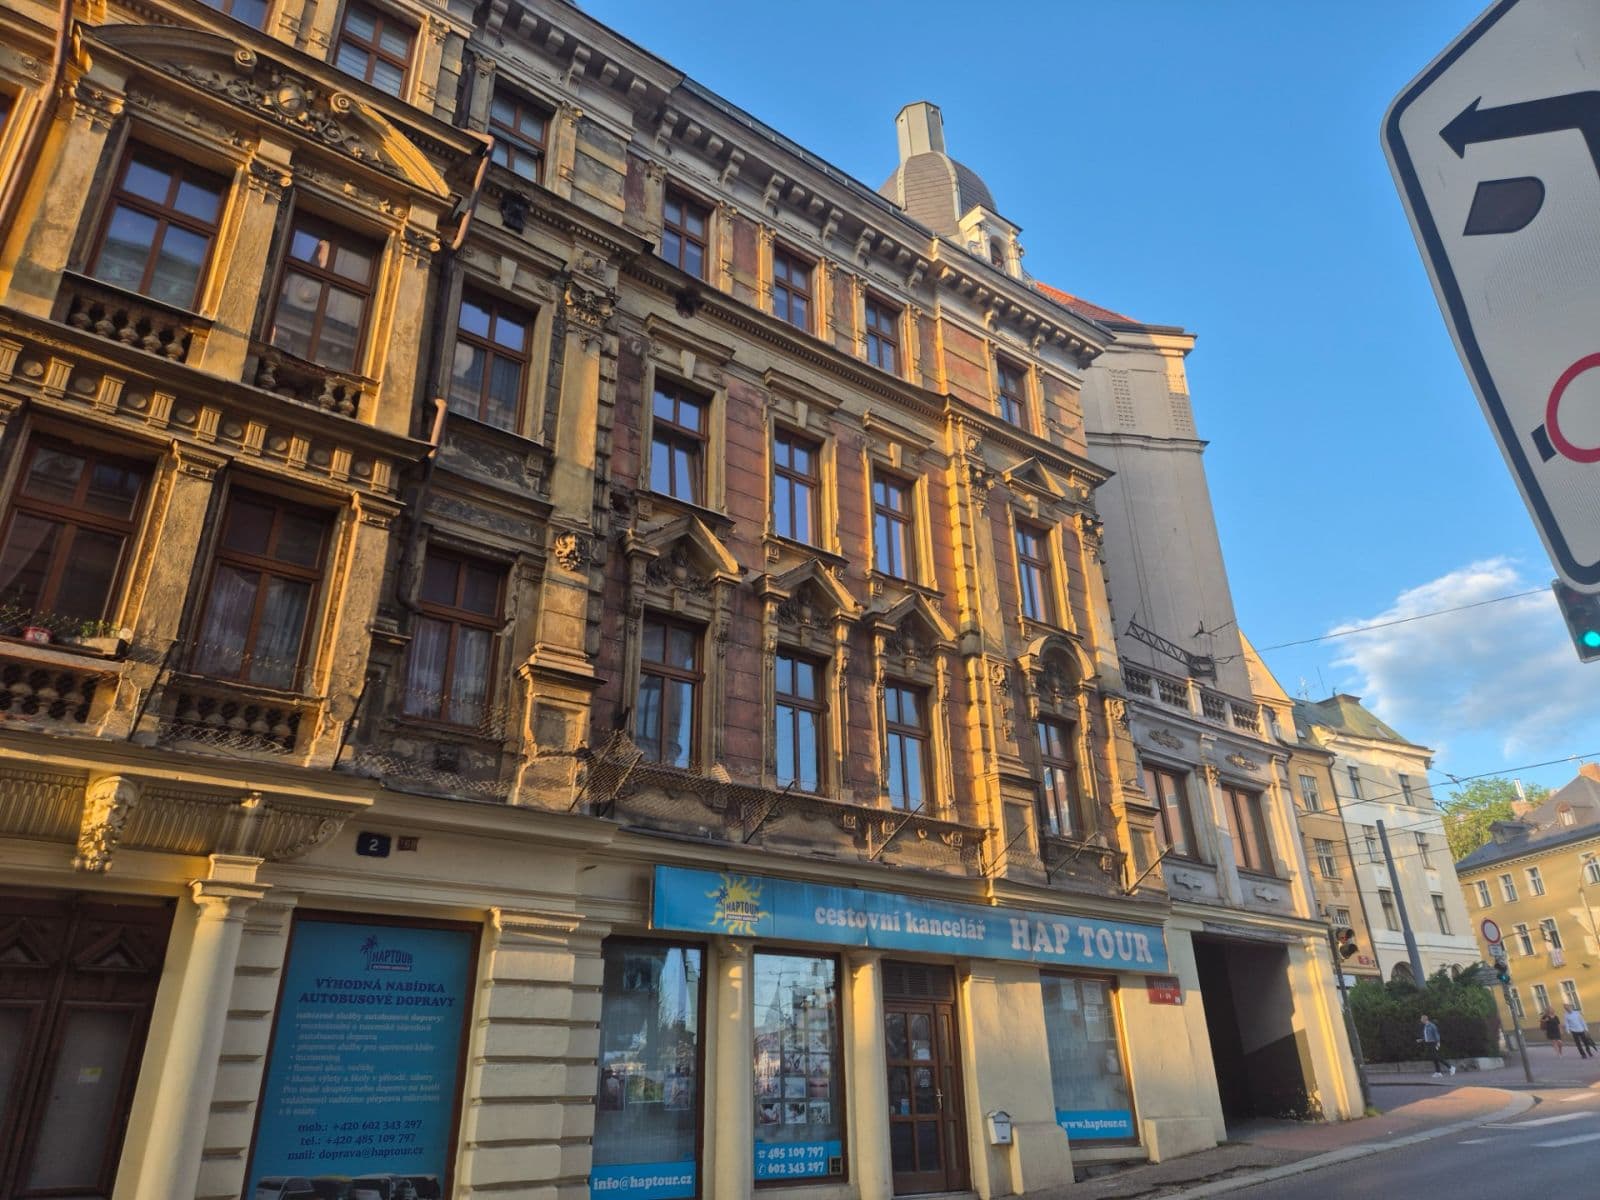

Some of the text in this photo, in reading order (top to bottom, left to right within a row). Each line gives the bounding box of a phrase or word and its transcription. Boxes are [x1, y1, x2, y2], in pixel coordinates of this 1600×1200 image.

[369, 839, 378, 851] 2
[815, 906, 1154, 964] cestovní kancelář HAP TOUR
[372, 950, 413, 963] HAPTOUR
[315, 977, 446, 993] VÝHODNÁ NABÍDKA
[299, 992, 455, 1007] AUTOBUSOVÉ DOPRAVY
[298, 1119, 422, 1132] mob.: +420 602 343 297
[1061, 1119, 1127, 1131] www.haptour.cz
[301, 1133, 416, 1146] tel.: +420 485 109 797
[288, 1148, 424, 1160] mail: doprava@haptour.cz
[768, 1146, 824, 1159] 485 109 797
[768, 1161, 824, 1174] 602 343 297
[593, 1174, 693, 1191] info@haptour.cz
